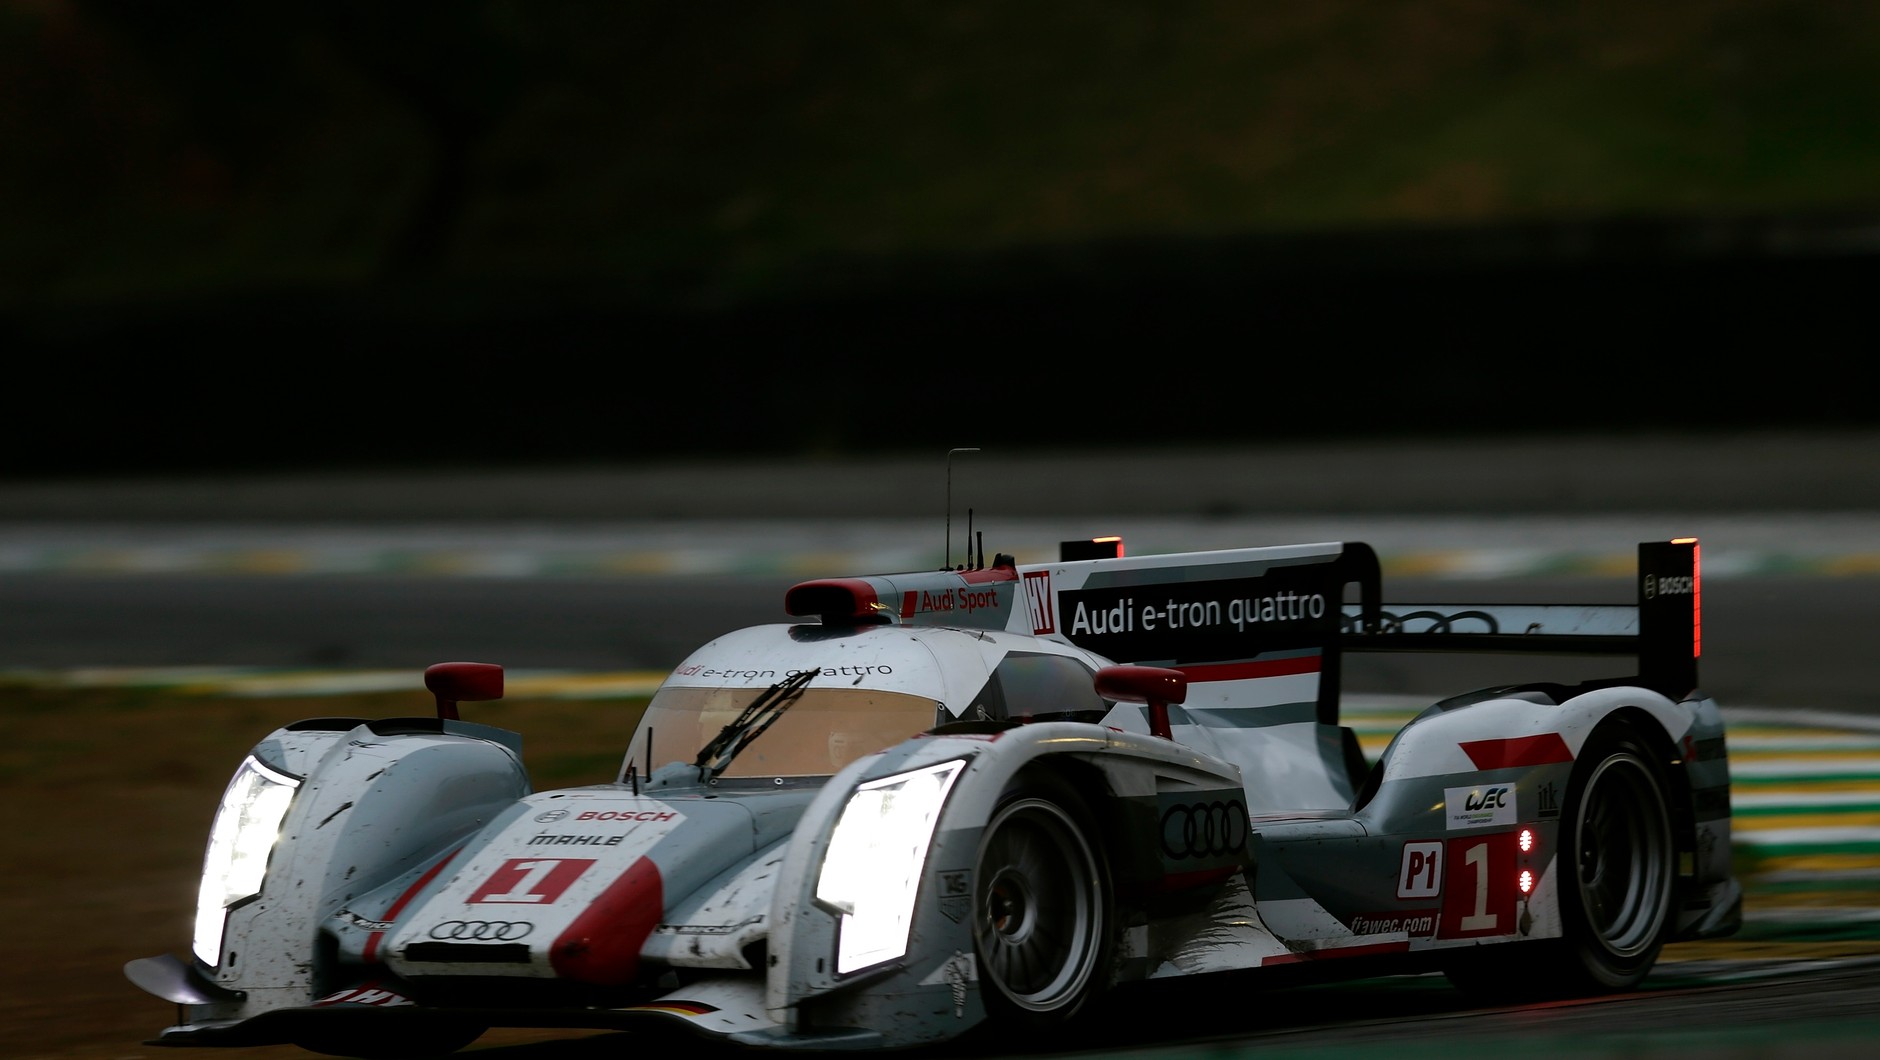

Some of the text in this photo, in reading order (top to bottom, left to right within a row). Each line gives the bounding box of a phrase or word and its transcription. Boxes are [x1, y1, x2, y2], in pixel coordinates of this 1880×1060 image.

[1658, 576, 1694, 596] BOSCH
[921, 587, 999, 614] Audi Sport
[1024, 575, 1051, 631] HY
[1071, 590, 1326, 636] Audi e-tron quattro
[702, 667, 775, 679] e-tron
[786, 664, 893, 680] qattro
[1465, 787, 1508, 812] WEC
[575, 811, 678, 822] BOSCH
[527, 835, 624, 846] MAHLE
[480, 860, 563, 902] 1
[1406, 851, 1437, 890] P1
[1460, 843, 1498, 931] 1
[1350, 916, 1432, 935] fiawec.com
